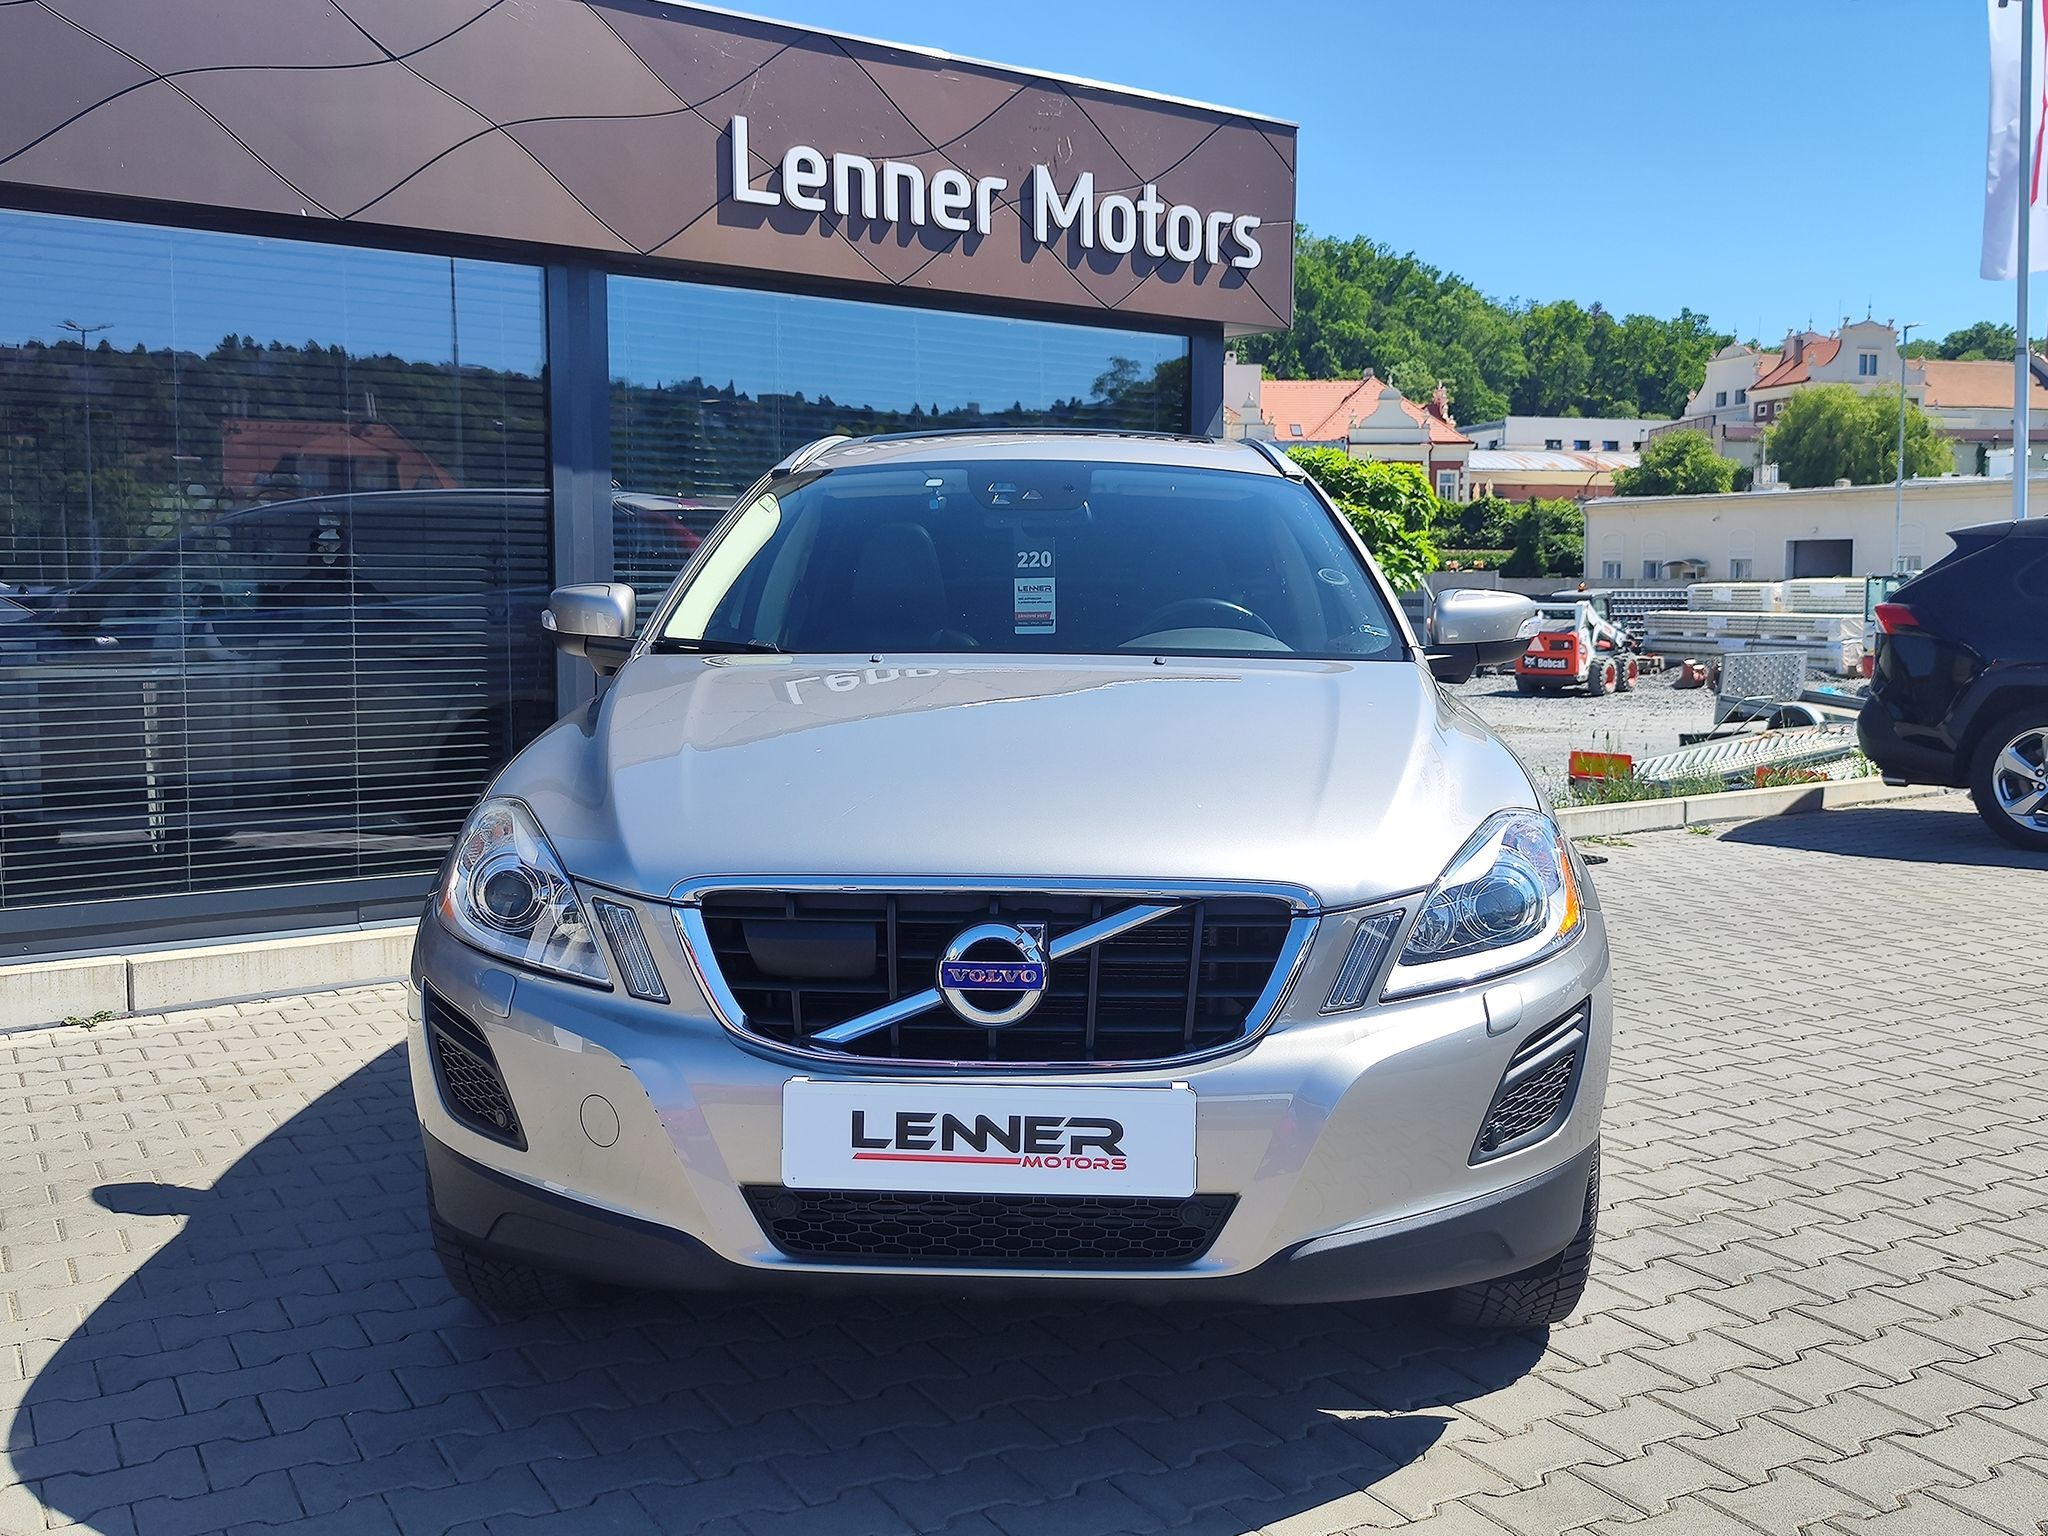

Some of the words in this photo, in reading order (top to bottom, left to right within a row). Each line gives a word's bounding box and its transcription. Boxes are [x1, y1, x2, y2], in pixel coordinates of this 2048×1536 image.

[731, 115, 1007, 235] Lenner
[1032, 164, 1262, 270] Motors
[1017, 550, 1052, 568] 220
[1017, 585, 1053, 593] LENNER
[1537, 658, 1566, 669] Bobcat
[948, 968, 1037, 983] VOLVO
[851, 1110, 1127, 1157] LENNER
[1021, 1155, 1127, 1171] MOTORS
